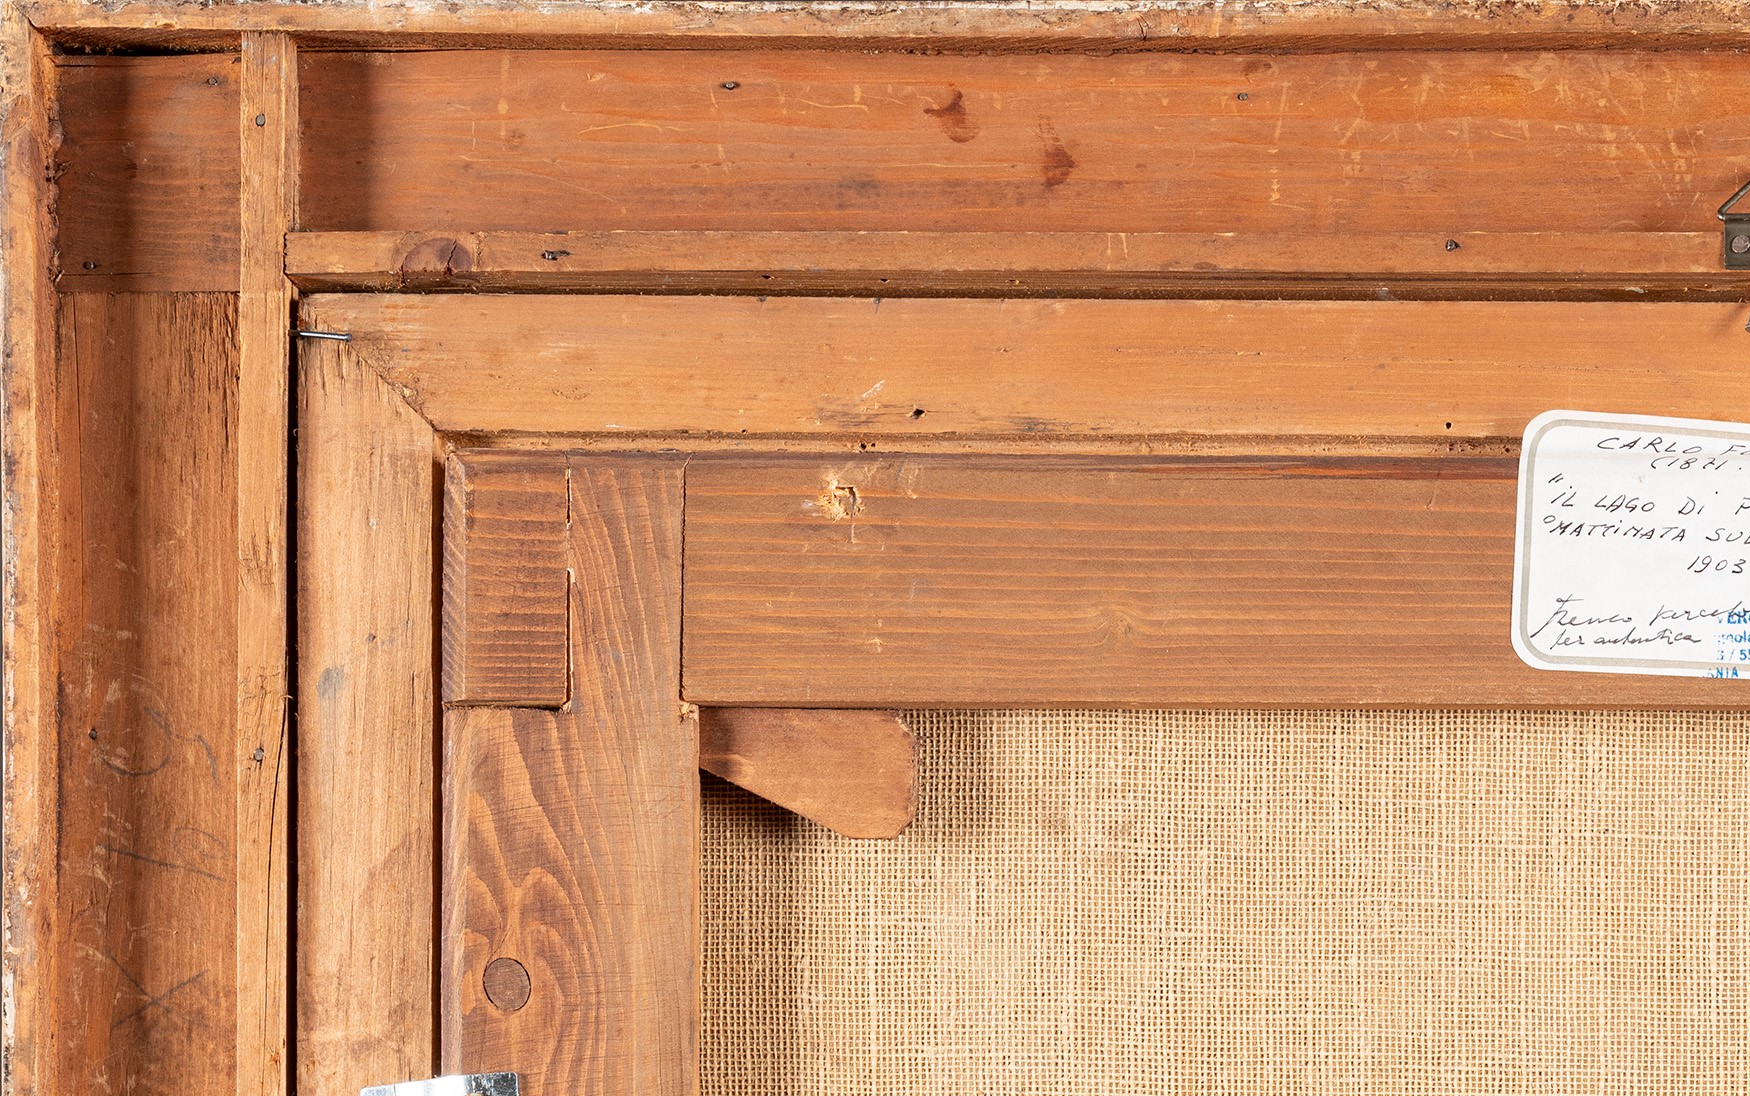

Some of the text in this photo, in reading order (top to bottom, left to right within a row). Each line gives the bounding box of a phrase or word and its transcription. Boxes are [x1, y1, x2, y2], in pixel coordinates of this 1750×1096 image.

[1597, 437, 1702, 454] CARLO
[1594, 494, 1656, 513] LAGO
[1687, 555, 1747, 574] 1903
